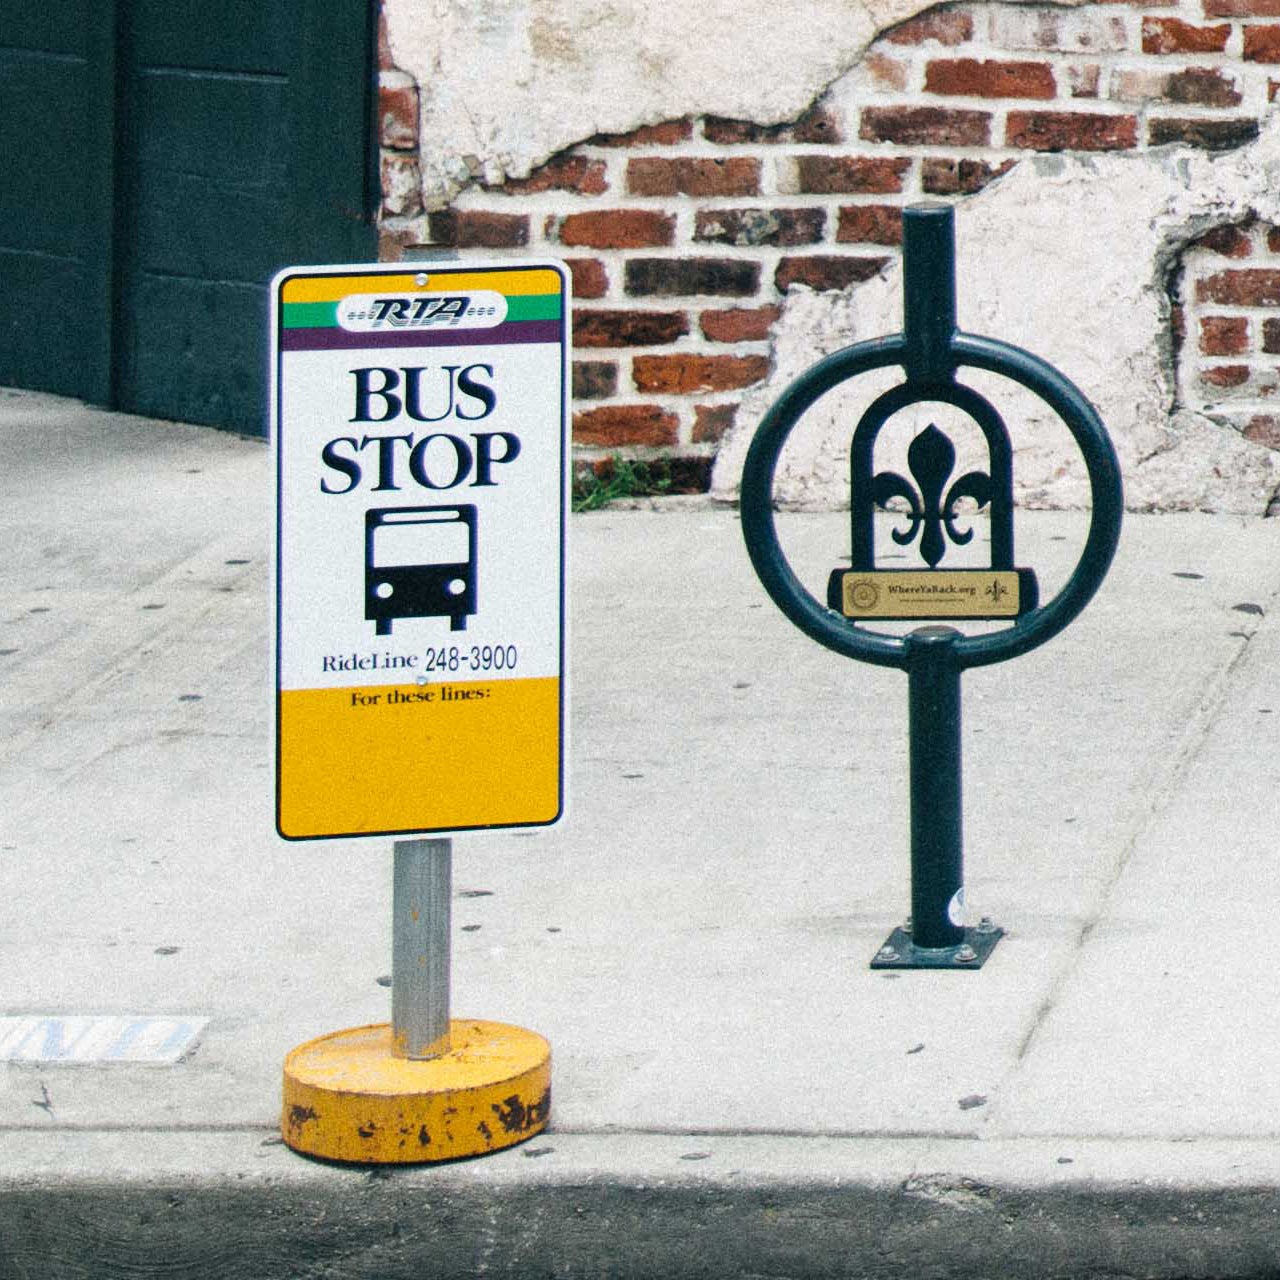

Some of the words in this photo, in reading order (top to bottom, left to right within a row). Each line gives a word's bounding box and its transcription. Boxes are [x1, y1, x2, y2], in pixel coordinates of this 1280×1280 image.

[371, 296, 471, 325] RTA
[348, 363, 497, 423] BUS
[320, 431, 522, 494] STOP
[888, 584, 977, 596] WhereYaRack.org
[322, 651, 418, 672] RideLine
[425, 644, 518, 672] 248-3900
[351, 692, 382, 706] For
[387, 689, 435, 705] these
[441, 686, 491, 701] lines:
